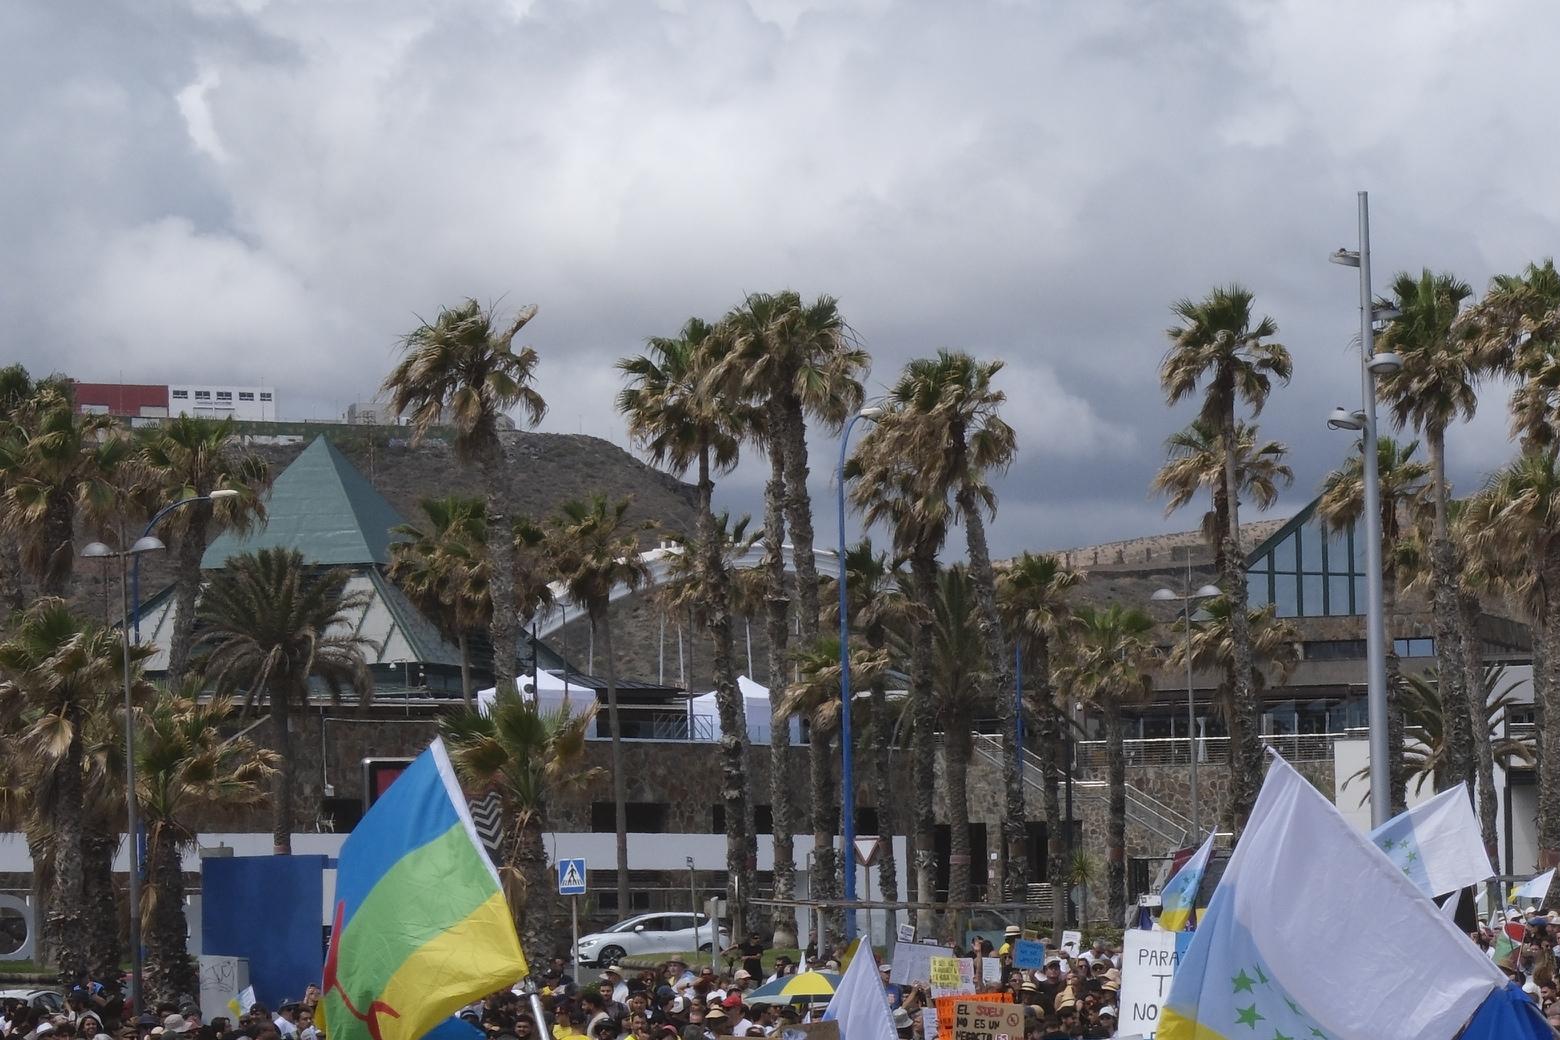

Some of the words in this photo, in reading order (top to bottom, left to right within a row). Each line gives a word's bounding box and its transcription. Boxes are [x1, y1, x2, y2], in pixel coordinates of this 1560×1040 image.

[957, 1004, 970, 1015] EL
[956, 1017, 968, 1028] NO
[974, 1020, 985, 1028] ES
[989, 1020, 1000, 1030] UN
